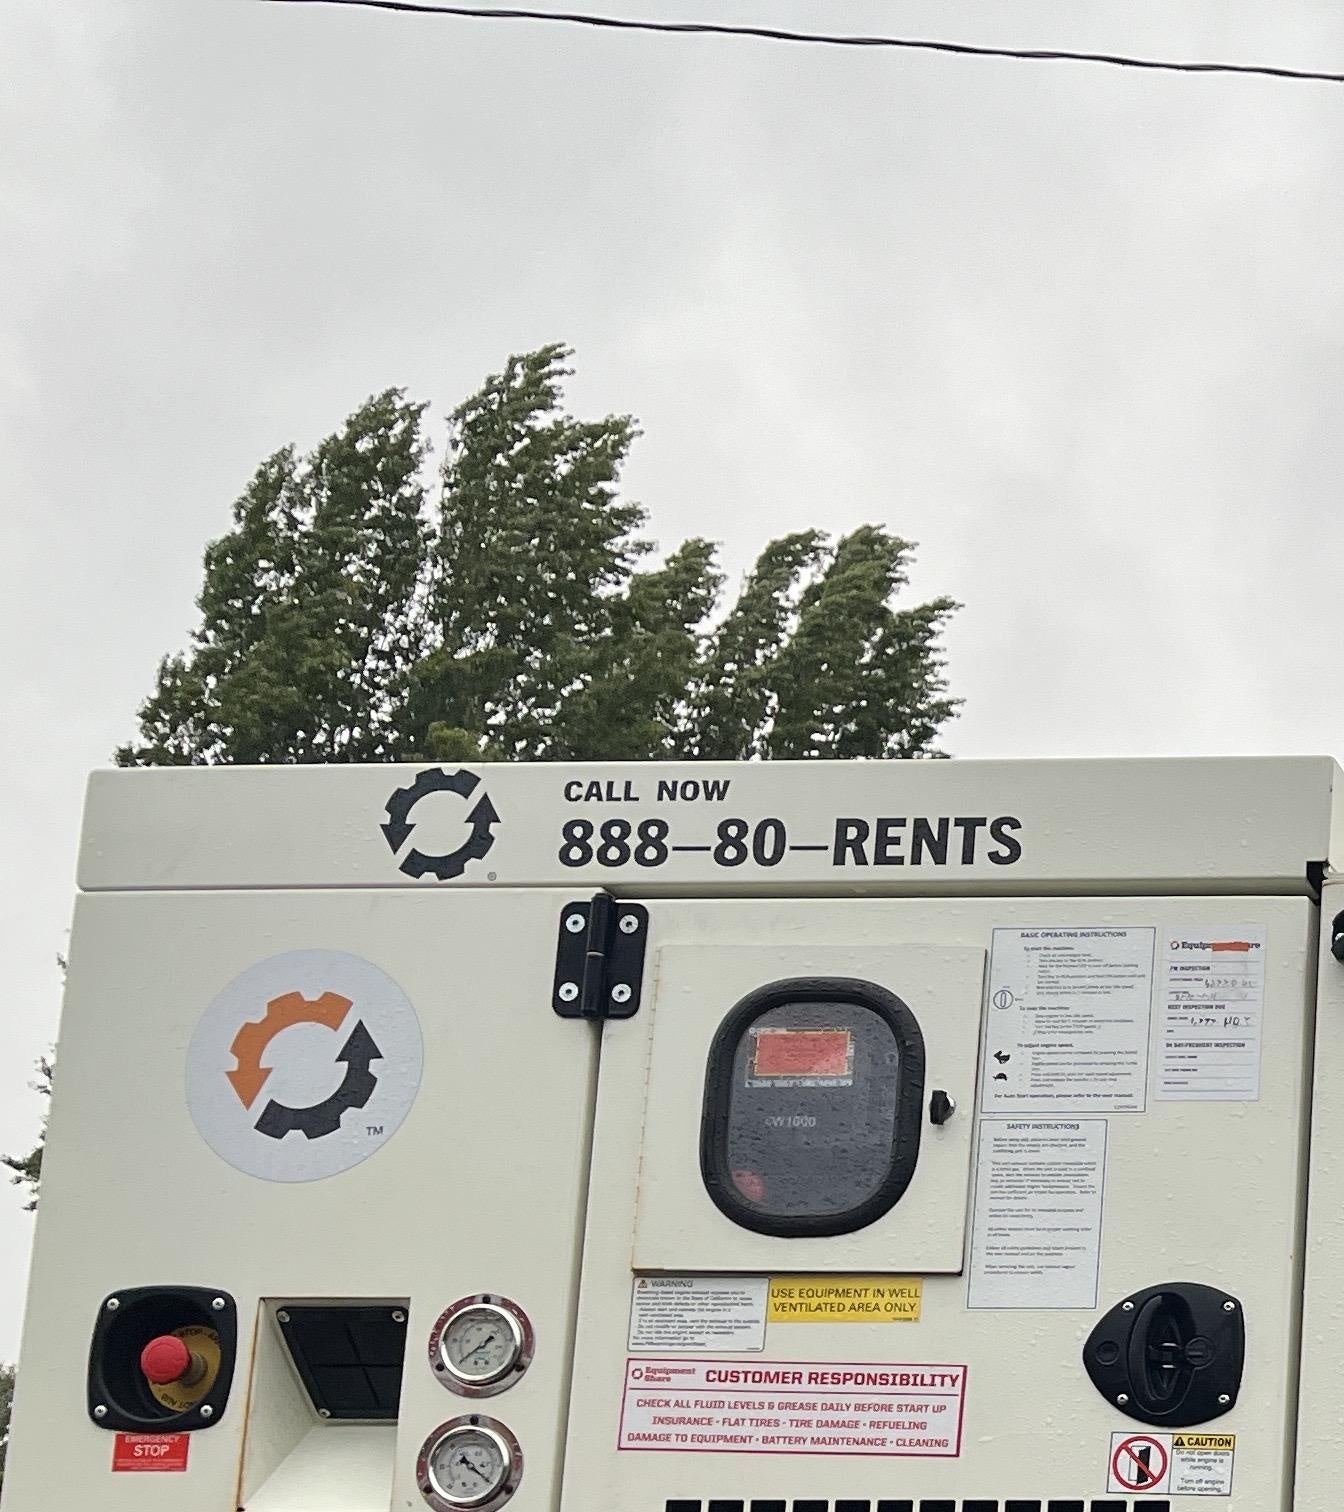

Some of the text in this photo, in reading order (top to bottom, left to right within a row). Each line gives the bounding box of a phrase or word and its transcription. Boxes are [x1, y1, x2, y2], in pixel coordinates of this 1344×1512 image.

[563, 779, 731, 802] CALL NOW
[650, 1280, 693, 1288] WARNING
[771, 1288, 920, 1298] USE EQUIPMENT IN WELL
[774, 1302, 916, 1313] VENTILATED AREA ONLY
[645, 1367, 960, 1387] Equipment CUSTOMER RESPONSIBILITY
[645, 1374, 671, 1382] Share
[636, 1399, 672, 1408] CHECK
[673, 1399, 691, 1408] ALL
[694, 1400, 725, 1409] FLUID
[727, 1400, 765, 1410] LEVELS
[777, 1402, 818, 1411] GREASE
[820, 1402, 851, 1412] DAILY
[853, 1403, 894, 1412] BEFORE
[896, 1404, 930, 1413] START
[932, 1404, 947, 1413] UP
[652, 1416, 927, 1430] INSURANCE FLAT TIRES TIRE DAMAGE REFUELING
[125, 1435, 180, 1443] EMERGENCY
[627, 1432, 949, 1448] DAMAGE TO EQUIPMENT BATTERY MAINTENANCE CLEANING
[1188, 1438, 1232, 1447] CAUTION
[133, 1444, 170, 1457] STOP
